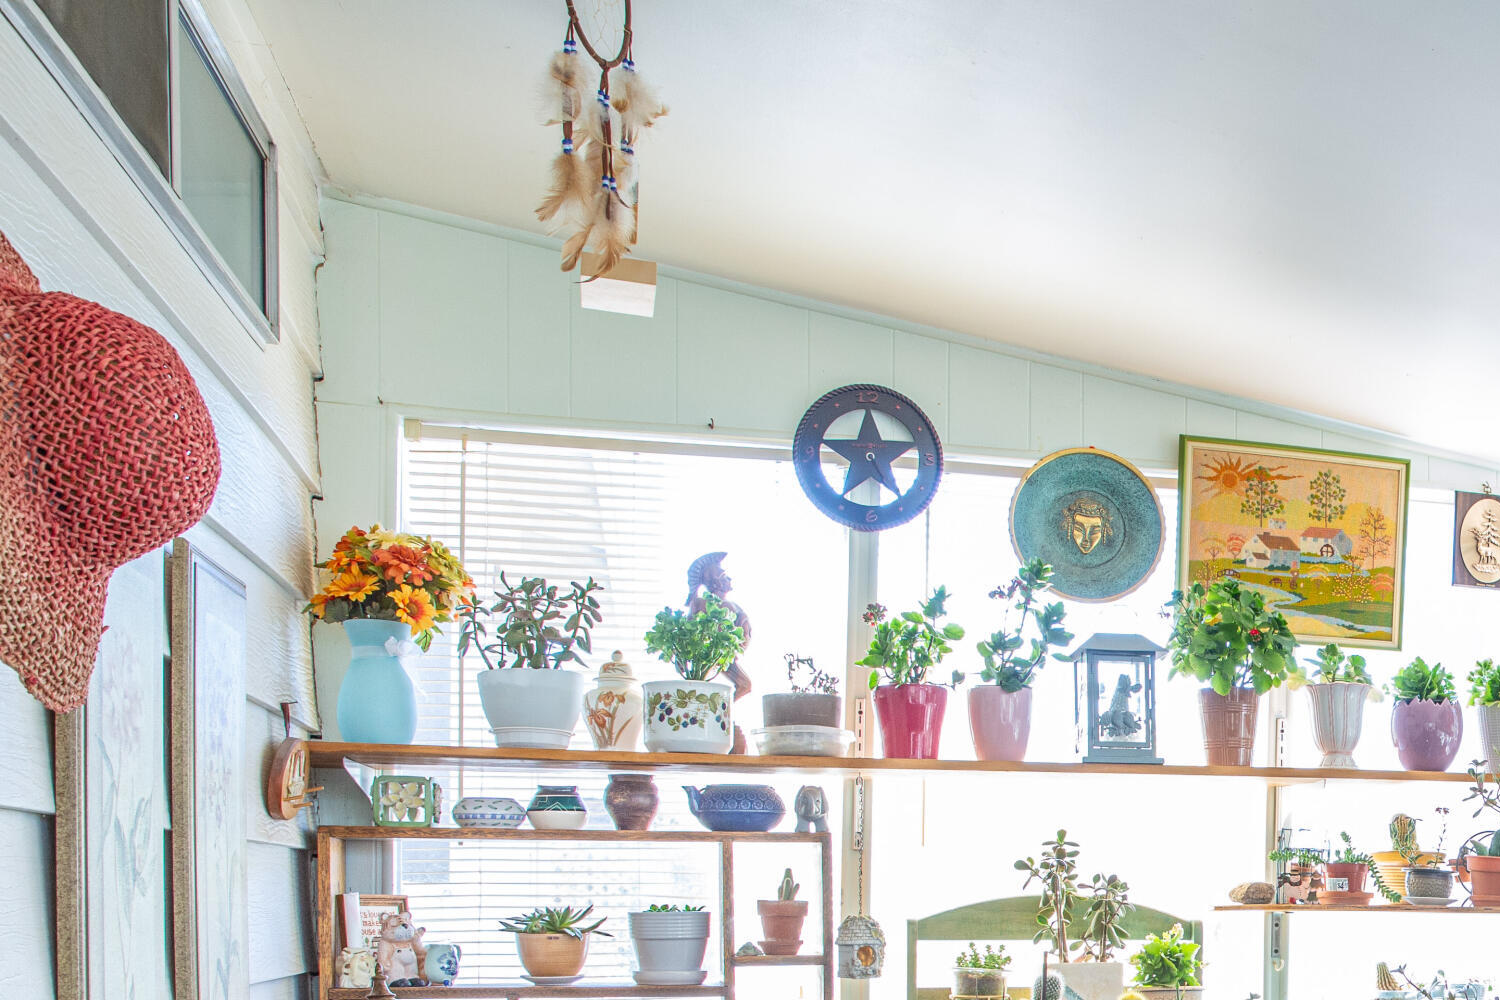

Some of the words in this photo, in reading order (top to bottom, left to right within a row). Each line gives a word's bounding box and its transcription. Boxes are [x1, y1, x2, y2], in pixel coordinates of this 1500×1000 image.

[856, 392, 880, 404] 12
[923, 453, 936, 466] 3
[865, 510, 878, 522] 6
